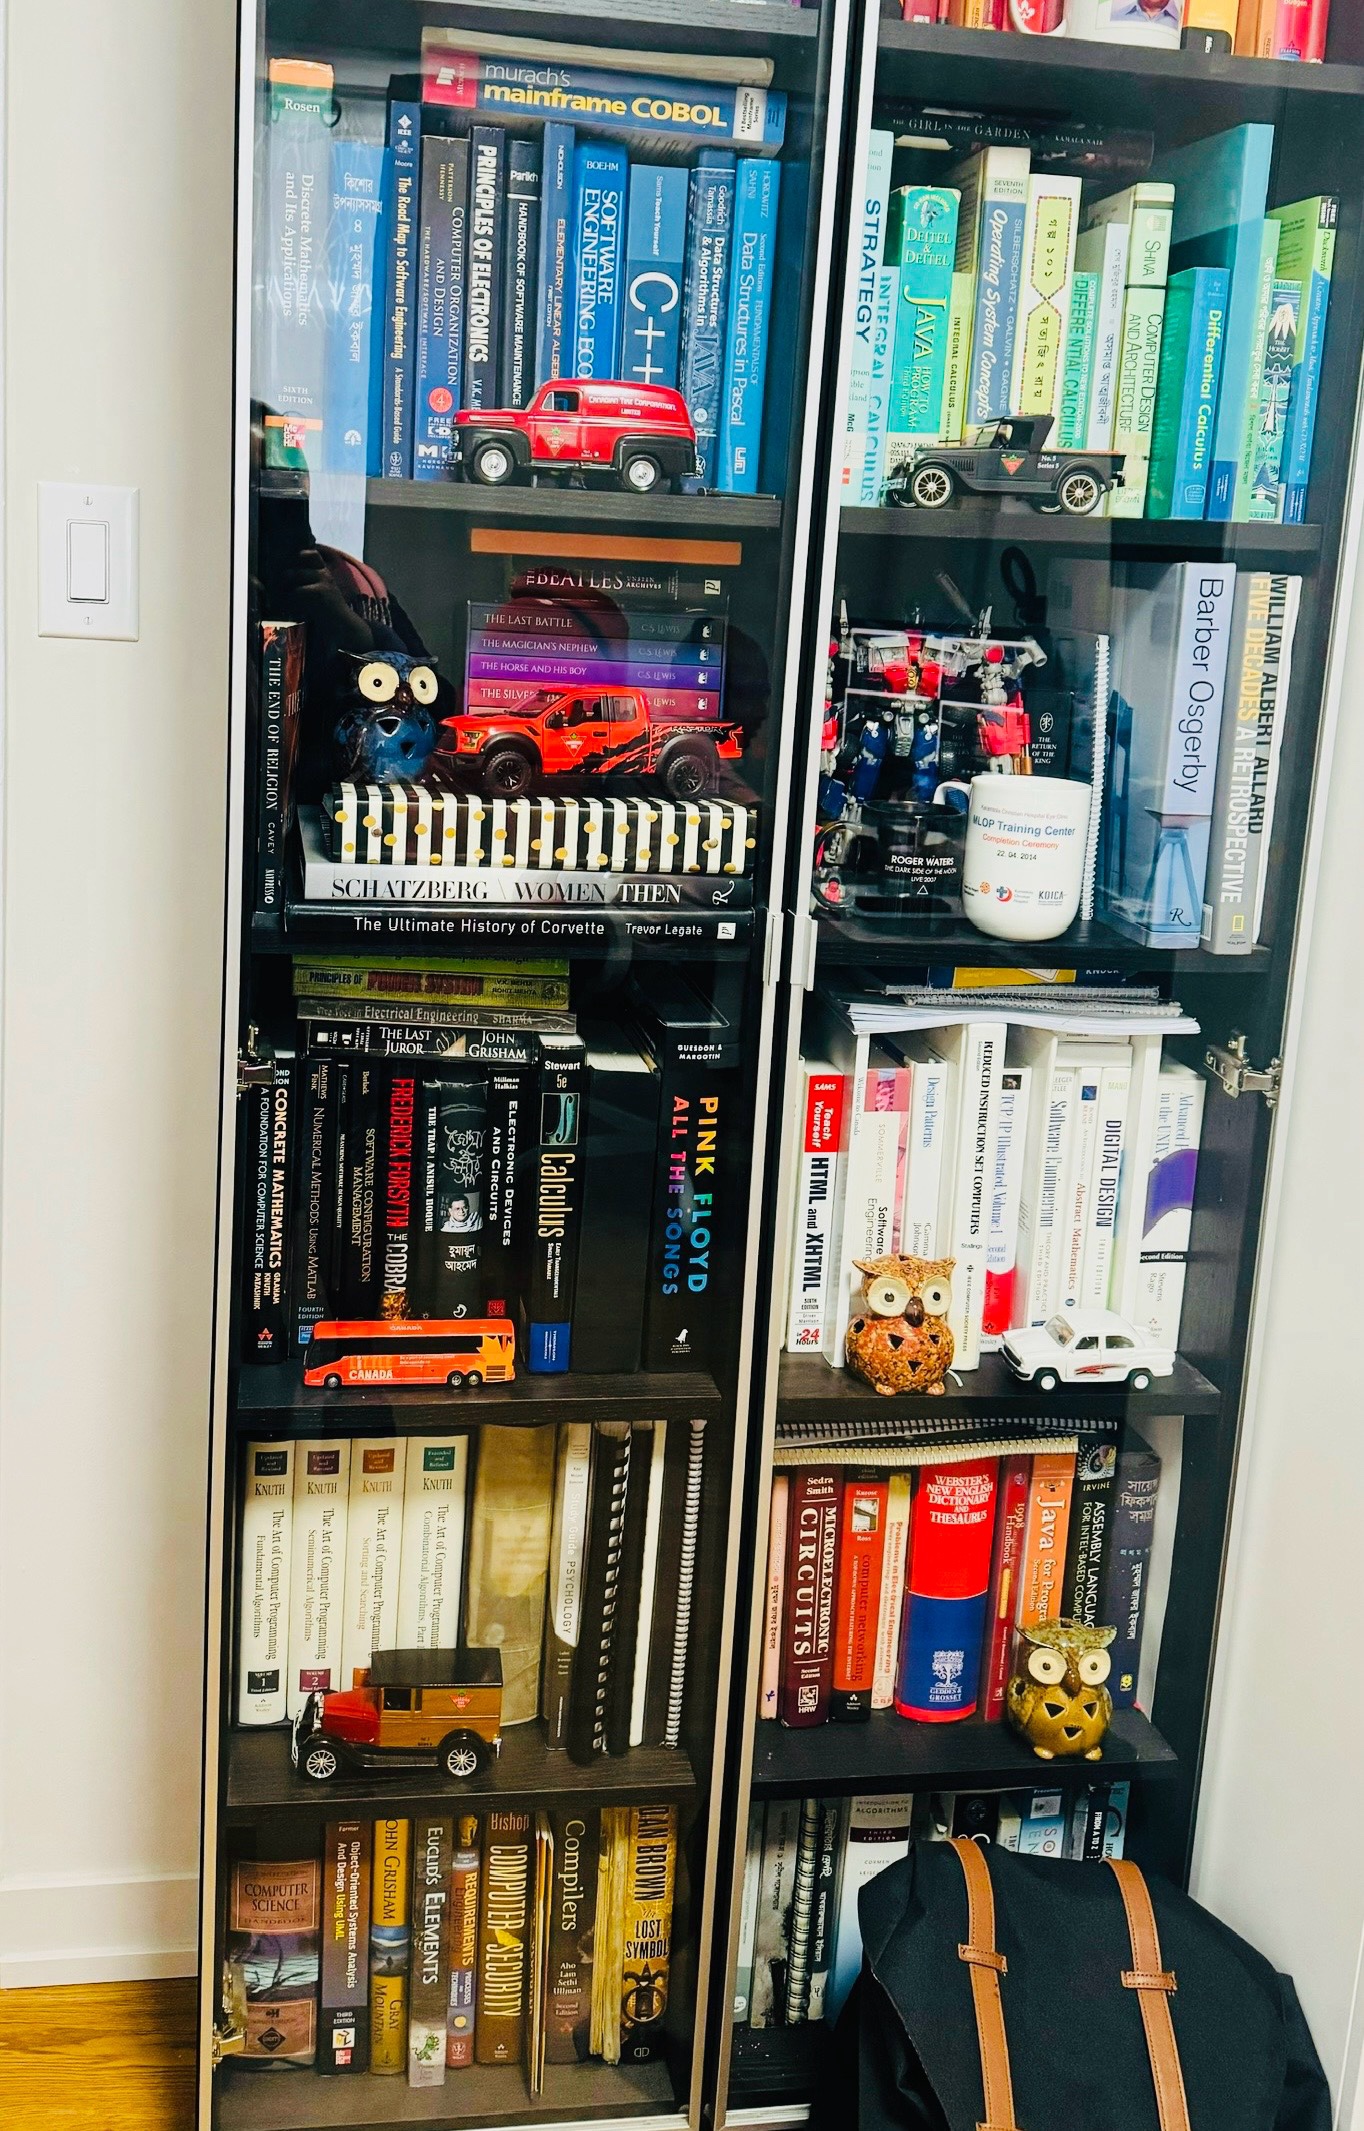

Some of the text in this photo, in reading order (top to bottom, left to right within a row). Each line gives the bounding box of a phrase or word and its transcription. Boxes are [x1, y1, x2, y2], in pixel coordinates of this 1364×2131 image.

[485, 64, 571, 86] murach's
[284, 98, 320, 112] Rosen
[484, 84, 727, 126] mainframe COBOL
[510, 170, 538, 181] Parikh
[587, 161, 618, 171] BOEHM
[299, 174, 314, 325] Discrete Mathematics
[469, 146, 497, 362] PRINCIPLES OF ELECTRONICS
[578, 189, 600, 330] ENGINEERING
[598, 191, 618, 304] SOFTWARE
[906, 228, 953, 266] DEITEL & DEITEL
[1142, 239, 1161, 276] SHIVA
[856, 199, 880, 343] STRATEGY
[433, 258, 445, 337] AND DESIGN
[448, 207, 464, 386] COMPUTER ORGANIZATION
[978, 209, 1007, 418] Operating System Concepts
[731, 233, 757, 426] Data Structures in Pascal
[904, 285, 946, 360] JAVA
[1119, 314, 1141, 432] AND ARCHITECTURE
[1137, 314, 1163, 432] COMPUTER DESIGN
[1193, 310, 1222, 470] Differential Calculus
[278, 396, 313, 404] EDITION
[484, 613, 572, 627] THE LAST BATTLE
[482, 639, 598, 652] THE MAGICIAN'S NEPHEW
[1174, 578, 1223, 793] Barber Osgerby
[1248, 576, 1289, 834] WILLIAM ALBERT ALLARD
[973, 815, 1075, 837] MLOP Training Center
[983, 834, 1059, 850] Completion Ceremony
[332, 879, 682, 903] SCHATZBERG WOMEN THEN
[1039, 891, 1063, 900] KOICA
[354, 918, 702, 936] The Ultimate History of Corvette Trevor Legate
[364, 1006, 532, 1024] Electrical Engineering SHARMA
[380, 1027, 431, 1040] THE LAST
[385, 1040, 424, 1055] JUROR
[481, 1031, 515, 1044] JOHN
[469, 1044, 526, 1059] GRISHAM
[545, 1060, 580, 1071] Stewart
[814, 1083, 836, 1091] SAMS
[811, 1101, 825, 1149] Yourself
[822, 1107, 833, 1141] Teach
[921, 1077, 940, 1148] Design Patterns
[970, 1041, 992, 1235] REDUCED INSTRUCTION SET COMPUTERS
[269, 1088, 287, 1269] CONCRETE MATHEMATICS
[503, 1101, 518, 1246] ELECTRONIC DEVICES
[1096, 1120, 1122, 1227] DIGITAL DESIGN
[538, 1154, 575, 1237] Calculus
[663, 1097, 689, 1294] ALL THE SONGS
[688, 1097, 718, 1292] PINK FLOYD
[803, 1158, 829, 1292] HTML and XHTML
[876, 1206, 888, 1255] Software
[350, 1370, 393, 1379] CANADA
[255, 1483, 285, 1495] KNUTH
[307, 1482, 337, 1494] KNUTH
[363, 1480, 392, 1493] KNUTH
[423, 1478, 452, 1490] KNUTH
[806, 1486, 833, 1495] Smith
[807, 1477, 833, 1485] Sedra
[926, 1484, 993, 1494] NEW ENGLISH
[935, 1475, 989, 1486] WEBSTER'S
[1083, 1482, 1110, 1491] IRVINE
[570, 1493, 580, 1522] Study
[929, 1493, 989, 1504] DICTIONARY
[273, 1509, 284, 1527] The
[930, 1511, 987, 1524] THESAURUS
[272, 1529, 283, 1545] Art
[568, 1527, 577, 1555] Guide
[1002, 1515, 1013, 1564] Handbook
[253, 1535, 265, 1638] Fundamental Algorithms
[270, 1557, 283, 1602] Computer
[794, 1508, 818, 1656] CIRCUITS
[819, 1507, 836, 1656] MICROELECTRONIC
[563, 1561, 576, 1634] PSYCHOLOGY
[265, 1604, 281, 1660] Programming
[856, 1806, 908, 1815] ALGORITHMS
[635, 1807, 669, 1900] DAN BROWN
[244, 1882, 308, 1897] COMPUTER
[383, 1855, 400, 1919] GRISHAM
[558, 1820, 585, 1931] Compilers
[252, 1900, 299, 1911] SCIENCE
[422, 1827, 446, 1984] EUCLID'S ELEMENTS
[462, 1872, 478, 1965] REQUIREMENTS
[636, 1920, 662, 1939] LOST
[626, 1938, 669, 1959] SYMBOL
